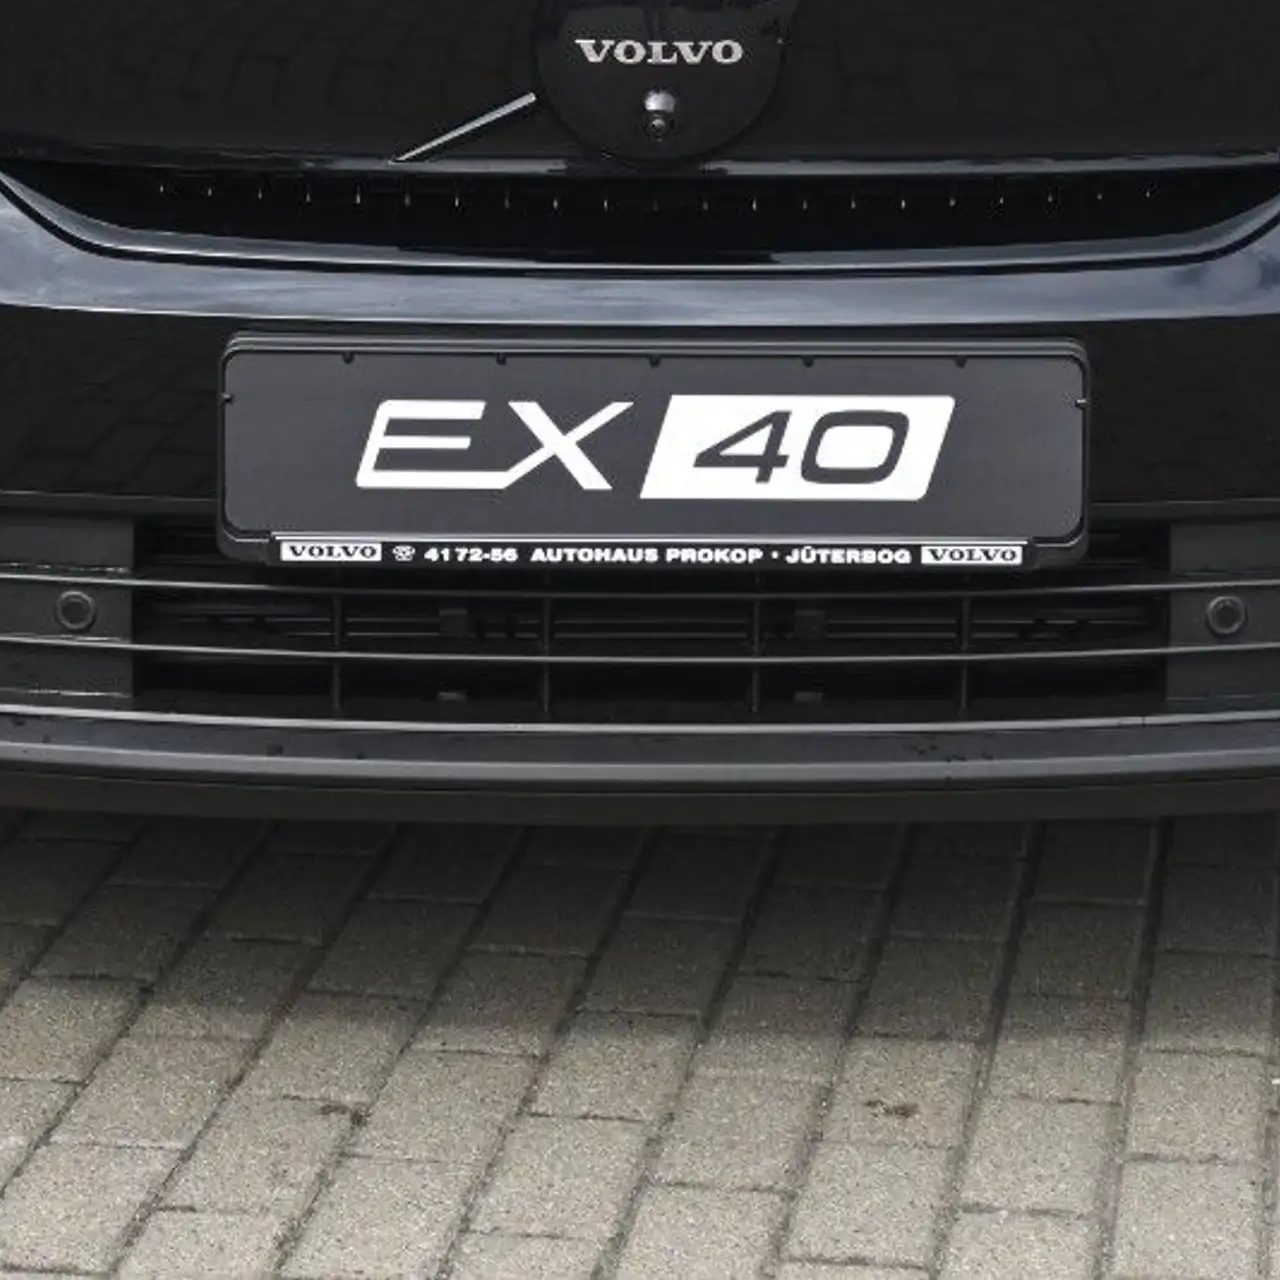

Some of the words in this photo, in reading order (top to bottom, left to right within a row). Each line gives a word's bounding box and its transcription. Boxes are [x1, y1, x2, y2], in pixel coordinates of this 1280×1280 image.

[575, 39, 744, 64] VOLVO
[355, 399, 634, 490] EX
[693, 409, 910, 485] 40
[289, 545, 378, 558] VOLVO
[530, 548, 659, 562] AUTOHAUS
[665, 548, 764, 563] PROKOP
[785, 546, 912, 564] JÜTERBOG
[928, 548, 1018, 562] VOLVO
